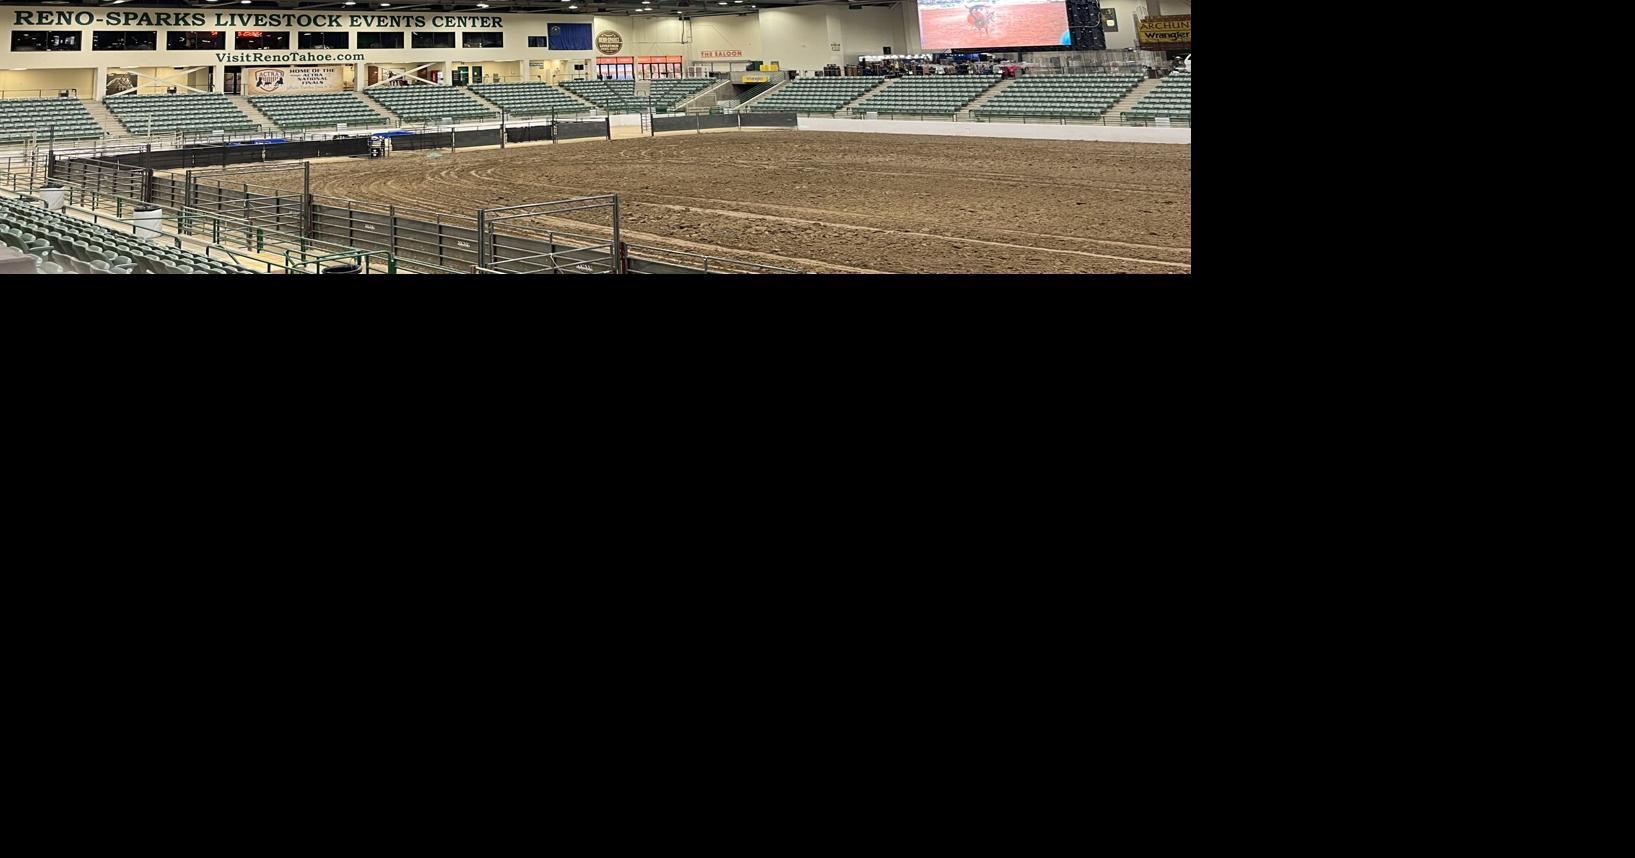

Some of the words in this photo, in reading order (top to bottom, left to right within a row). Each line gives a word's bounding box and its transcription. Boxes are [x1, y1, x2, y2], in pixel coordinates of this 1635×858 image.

[13, 10, 207, 27] RENO-SPARKS
[214, 13, 343, 27] LIVESTOCK
[349, 14, 426, 28] EVENTS
[432, 15, 503, 28] CENTER
[1145, 32, 1190, 41] Wrangler
[215, 51, 365, 63] VisitRenoTahoe.com
